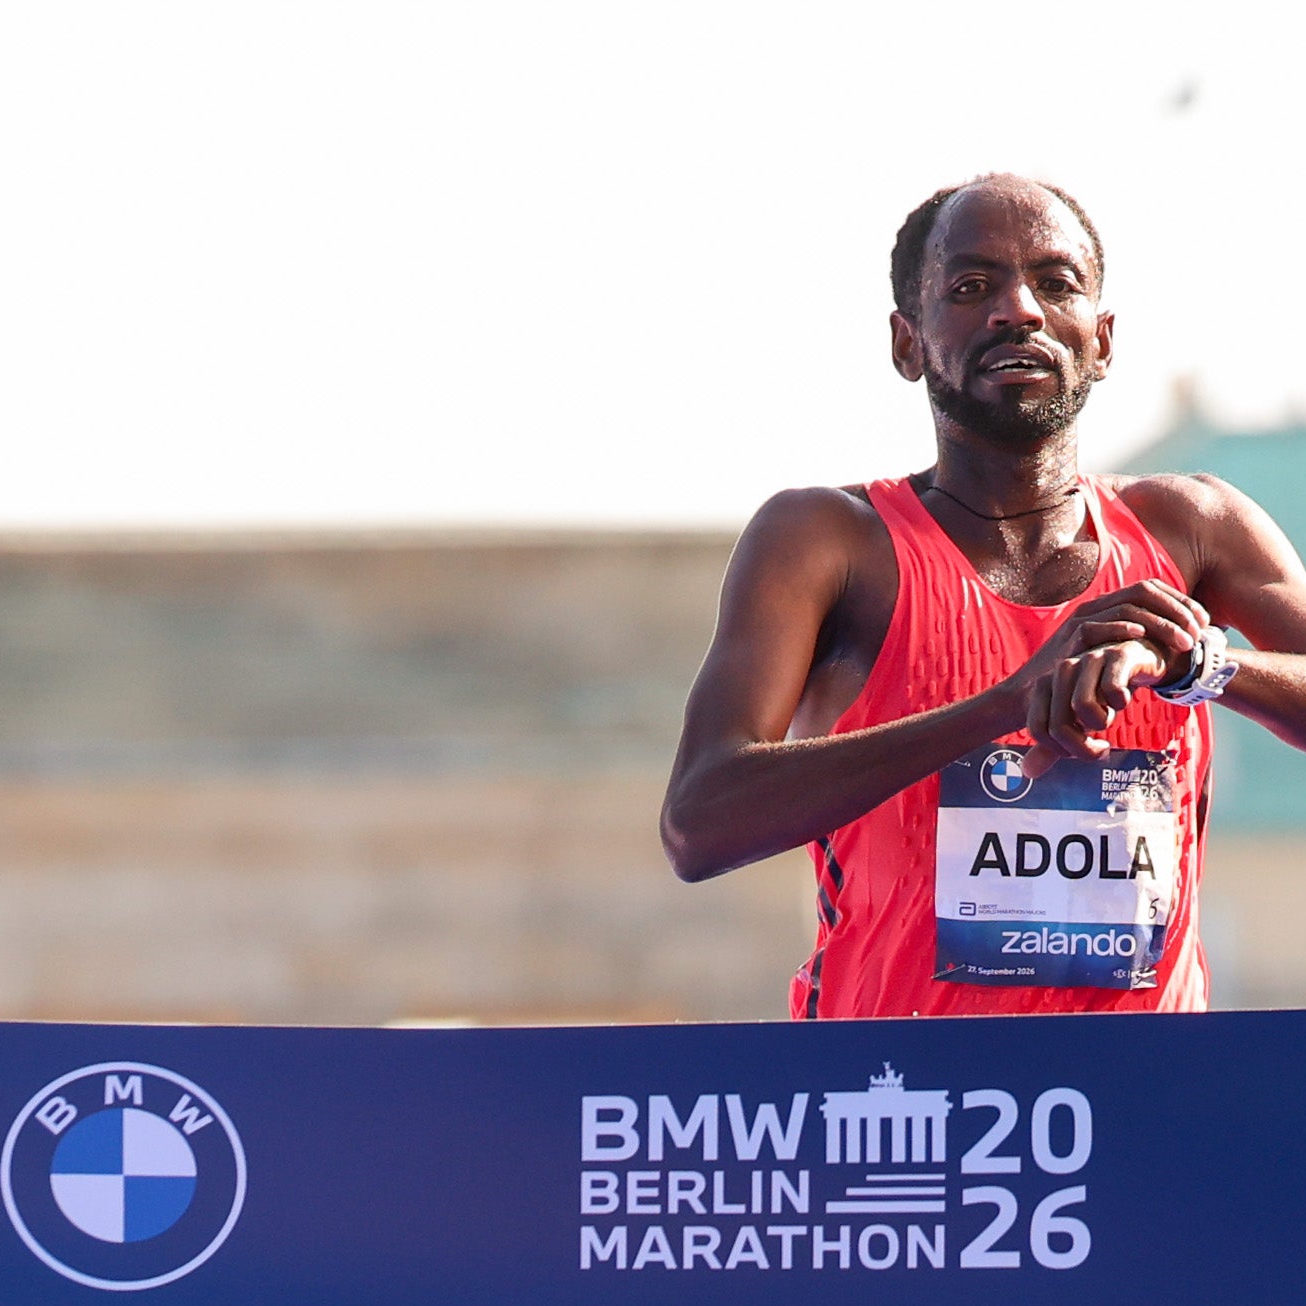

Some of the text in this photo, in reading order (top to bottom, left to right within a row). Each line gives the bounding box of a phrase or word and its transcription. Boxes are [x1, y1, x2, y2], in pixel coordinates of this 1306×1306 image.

[1102, 769, 1129, 782] BMW
[1140, 769, 1158, 785] 20
[1141, 785, 1159, 801] 26
[969, 832, 1156, 880] ADOLA
[1001, 927, 1137, 956] zalando
[978, 967, 1016, 976] September
[35, 1075, 214, 1136] BMW
[581, 1093, 810, 1162] BMW
[960, 1088, 1093, 1175] 20
[580, 1170, 810, 1215] BERLIN
[580, 1224, 945, 1270] MARATHON
[959, 1185, 1092, 1270] 26
